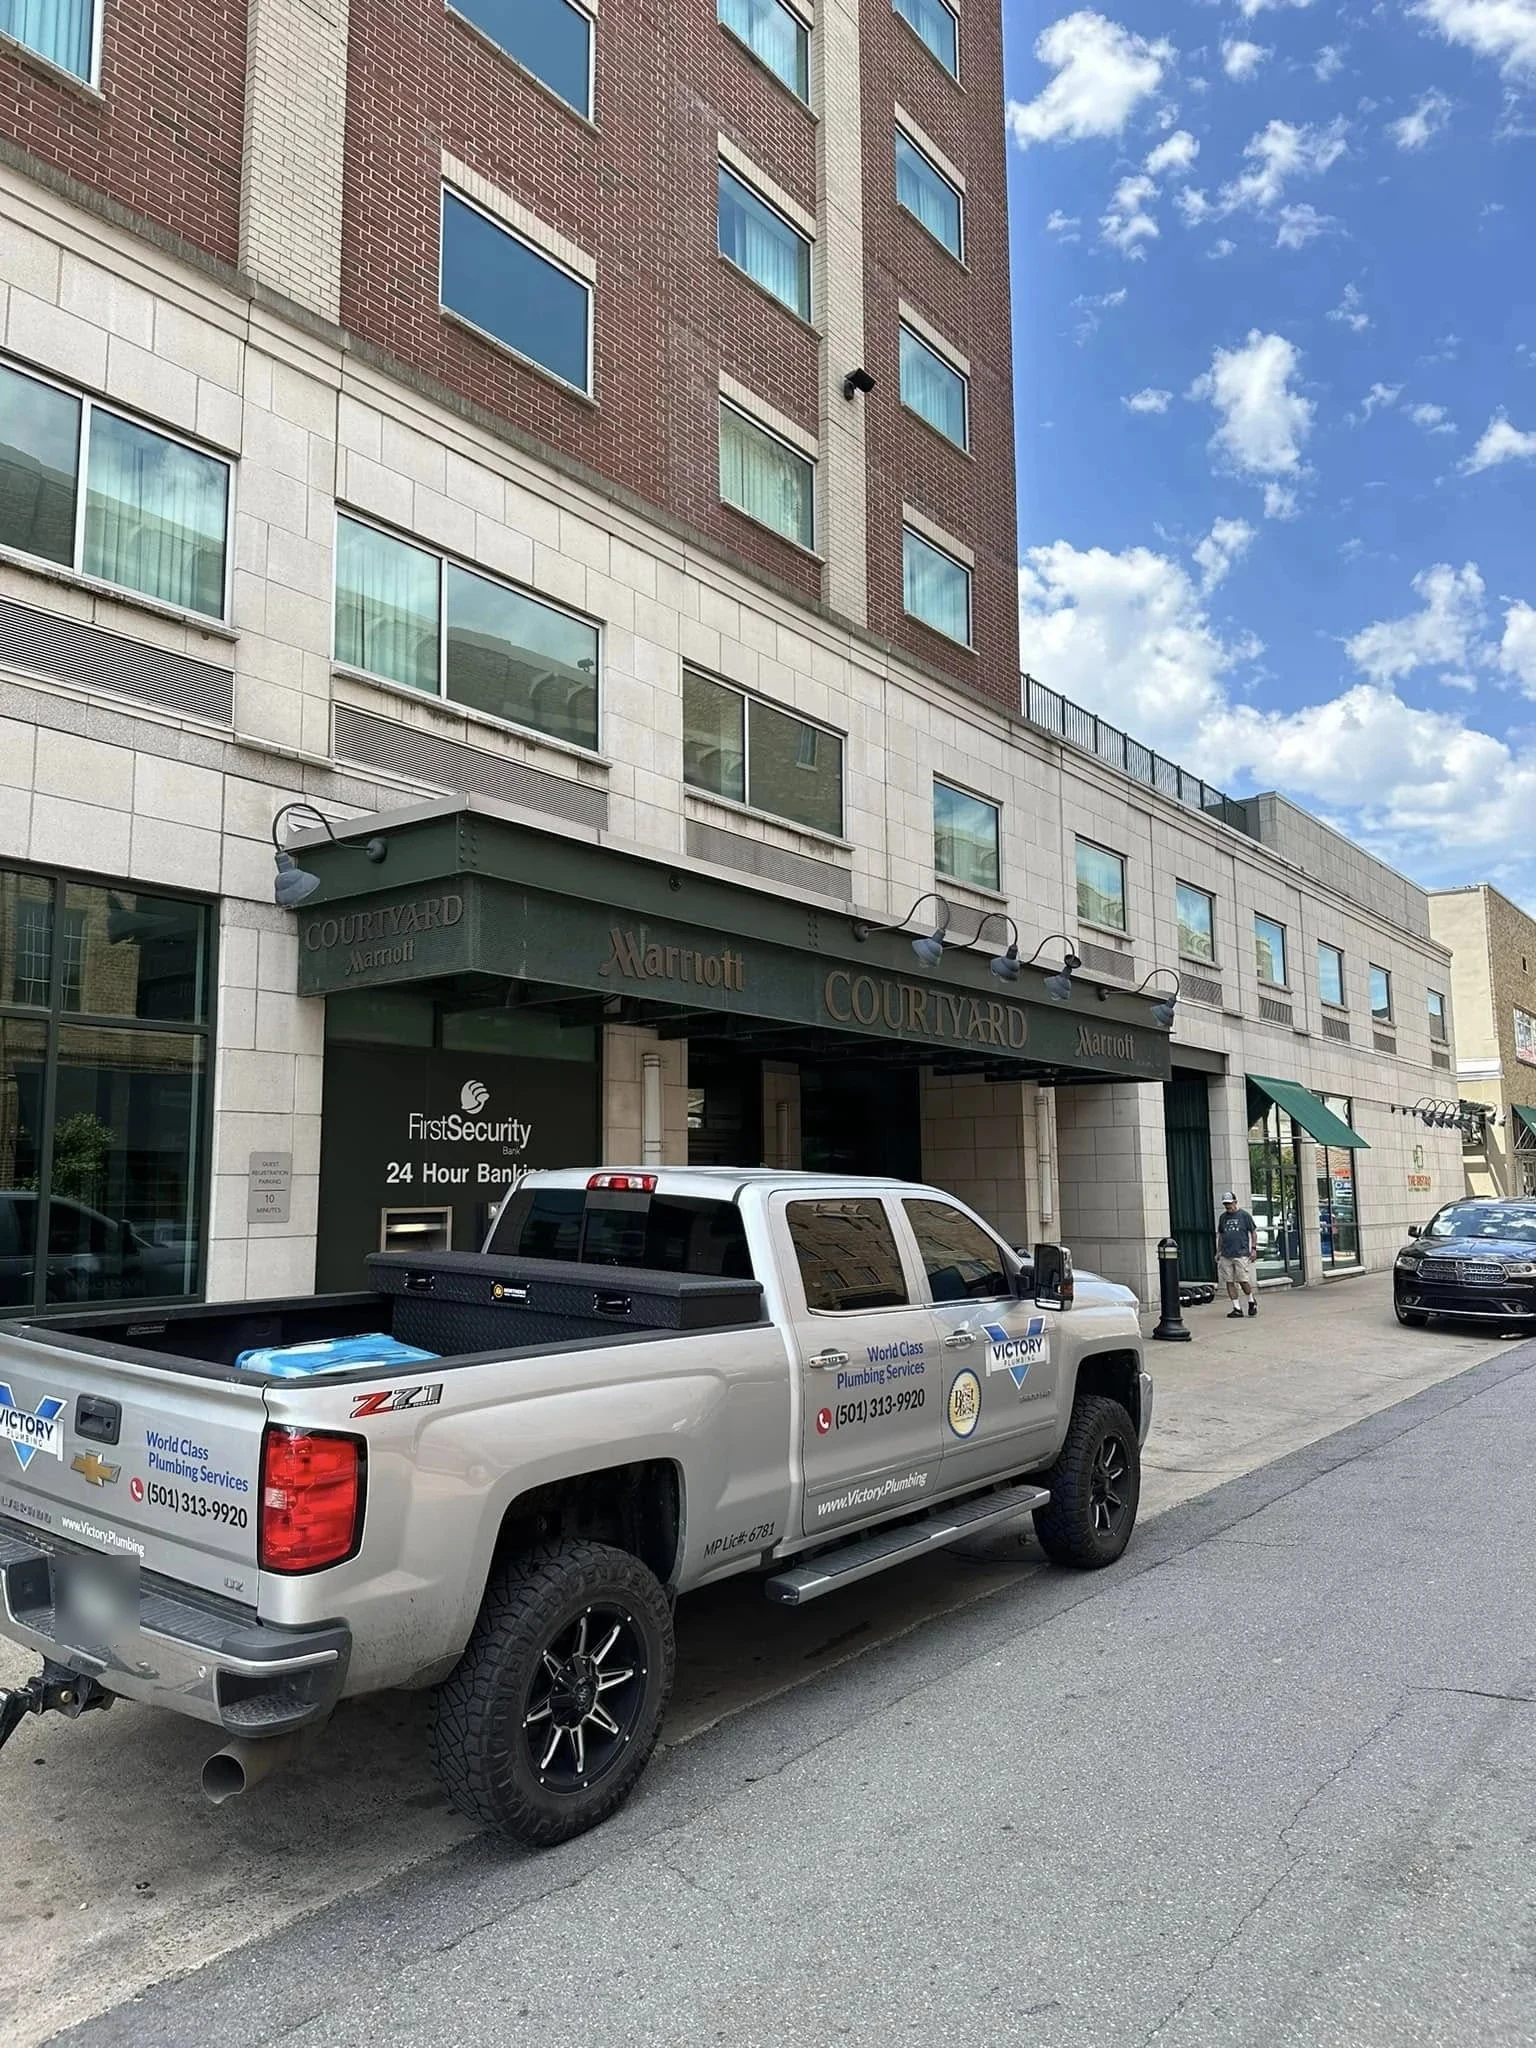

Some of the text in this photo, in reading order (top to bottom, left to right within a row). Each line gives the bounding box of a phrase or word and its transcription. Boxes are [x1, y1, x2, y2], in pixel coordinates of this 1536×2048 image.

[304, 895, 463, 952] COURTYARD
[344, 938, 415, 976] Marriott
[600, 927, 745, 991] Marriott
[824, 971, 1029, 1049] COURTYARD
[1074, 1024, 1135, 1060] Marriott
[409, 1113, 532, 1148] FirstSecurity
[502, 1146, 521, 1155] Bank
[386, 1162, 413, 1184] 24
[423, 1163, 469, 1184] Hour
[265, 1194, 275, 1204] 10
[866, 1341, 923, 1362] World Class
[993, 1338, 1043, 1361] VICTORY
[1003, 1355, 1036, 1367] PLUMBING
[837, 1361, 925, 1390] Plumbing Services
[350, 1383, 443, 1418] Z71
[835, 1388, 925, 1429] (501) 313-9920
[0, 1409, 54, 1441] VICTORY
[6, 1428, 43, 1448] PLUMBING
[147, 1431, 208, 1460] World Class
[149, 1454, 249, 1492] Plumbing Services
[147, 1481, 248, 1528] (501) 313-9920
[817, 1471, 928, 1516] www.Victory.Plumbing
[61, 1516, 145, 1557] www.Victory.Plumbing
[704, 1522, 775, 1559] MP Lic#: 6781
